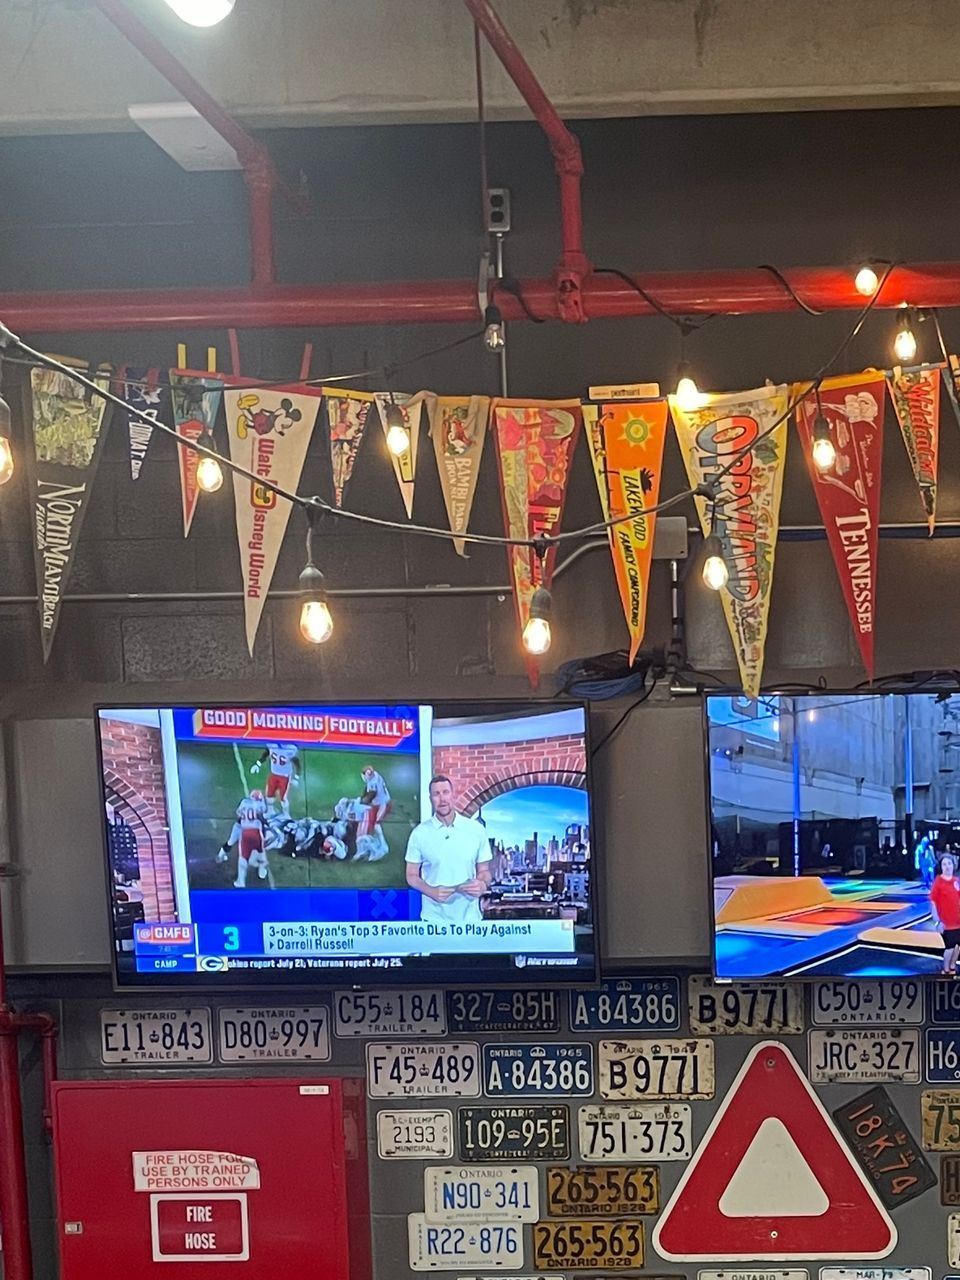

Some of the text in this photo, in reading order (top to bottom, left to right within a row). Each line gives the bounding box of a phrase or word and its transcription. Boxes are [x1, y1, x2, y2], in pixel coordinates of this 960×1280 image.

[258, 439, 274, 477] Walt
[454, 458, 472, 500] BAMBI
[38, 481, 86, 544] NORTH
[624, 476, 647, 541] LAKEWOOD
[618, 531, 638, 565] FAMILY
[248, 553, 265, 598] World
[835, 509, 872, 633] TENNESSEE
[204, 710, 401, 736] GOOD MORNING FOOTBALL
[155, 927, 190, 938] GMFB
[223, 927, 239, 950] 3
[269, 924, 531, 940] 3-on-3: Ryan's Top 3 Favorite DLs To Play Against
[277, 939, 354, 949] Darrell Russell
[154, 960, 178, 969] CAMP
[277, 959, 294, 970] July
[372, 958, 389, 968] July
[132, 1012, 177, 1020] ONTARIO
[104, 1022, 204, 1051] E11 843
[224, 1019, 323, 1048] D80 997
[816, 1042, 914, 1070] JRC 327
[374, 1055, 475, 1084] F45 489
[393, 1126, 435, 1143] 2193
[464, 1119, 565, 1149] 109 95E
[142, 1165, 250, 1176] USE BY TRAINED
[145, 1155, 173, 1165] FIRE
[178, 1154, 215, 1164] HOSE
[147, 1176, 246, 1188] PERSONS ONLY
[443, 1182, 530, 1209] N90 341
[186, 1206, 212, 1222] FIRE
[185, 1233, 216, 1249] HOSE
[427, 1227, 517, 1254] R22 876
[546, 1258, 631, 1267] ONTARIO 1928
